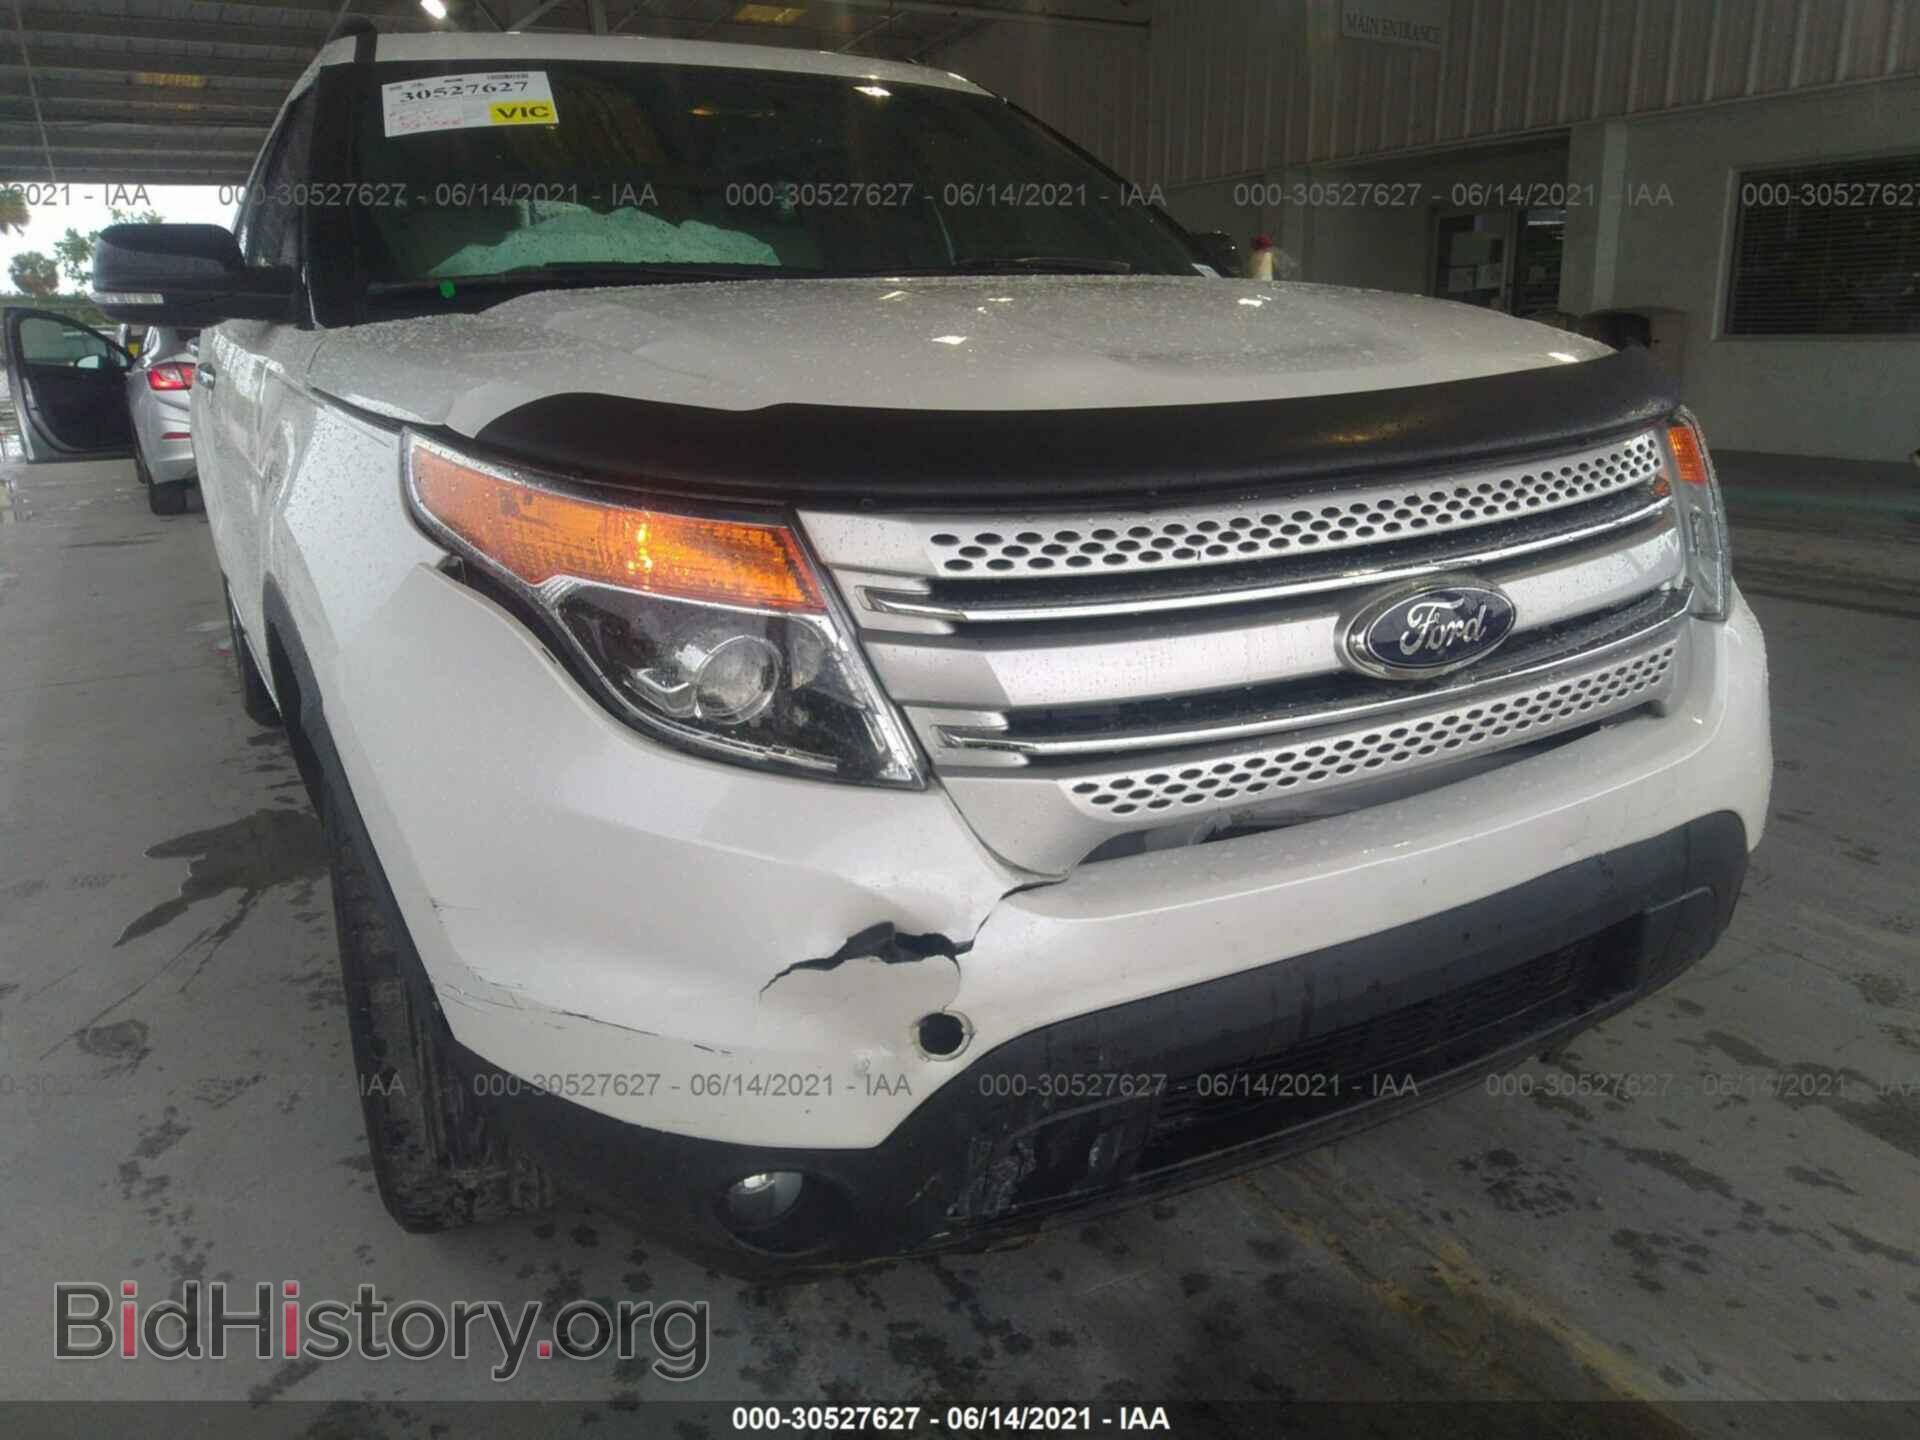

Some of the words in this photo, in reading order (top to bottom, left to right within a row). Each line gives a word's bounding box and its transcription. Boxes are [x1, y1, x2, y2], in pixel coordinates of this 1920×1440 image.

[400, 81, 529, 103] 30527627
[496, 106, 550, 119] VIC
[1400, 599, 1488, 655] Ford
